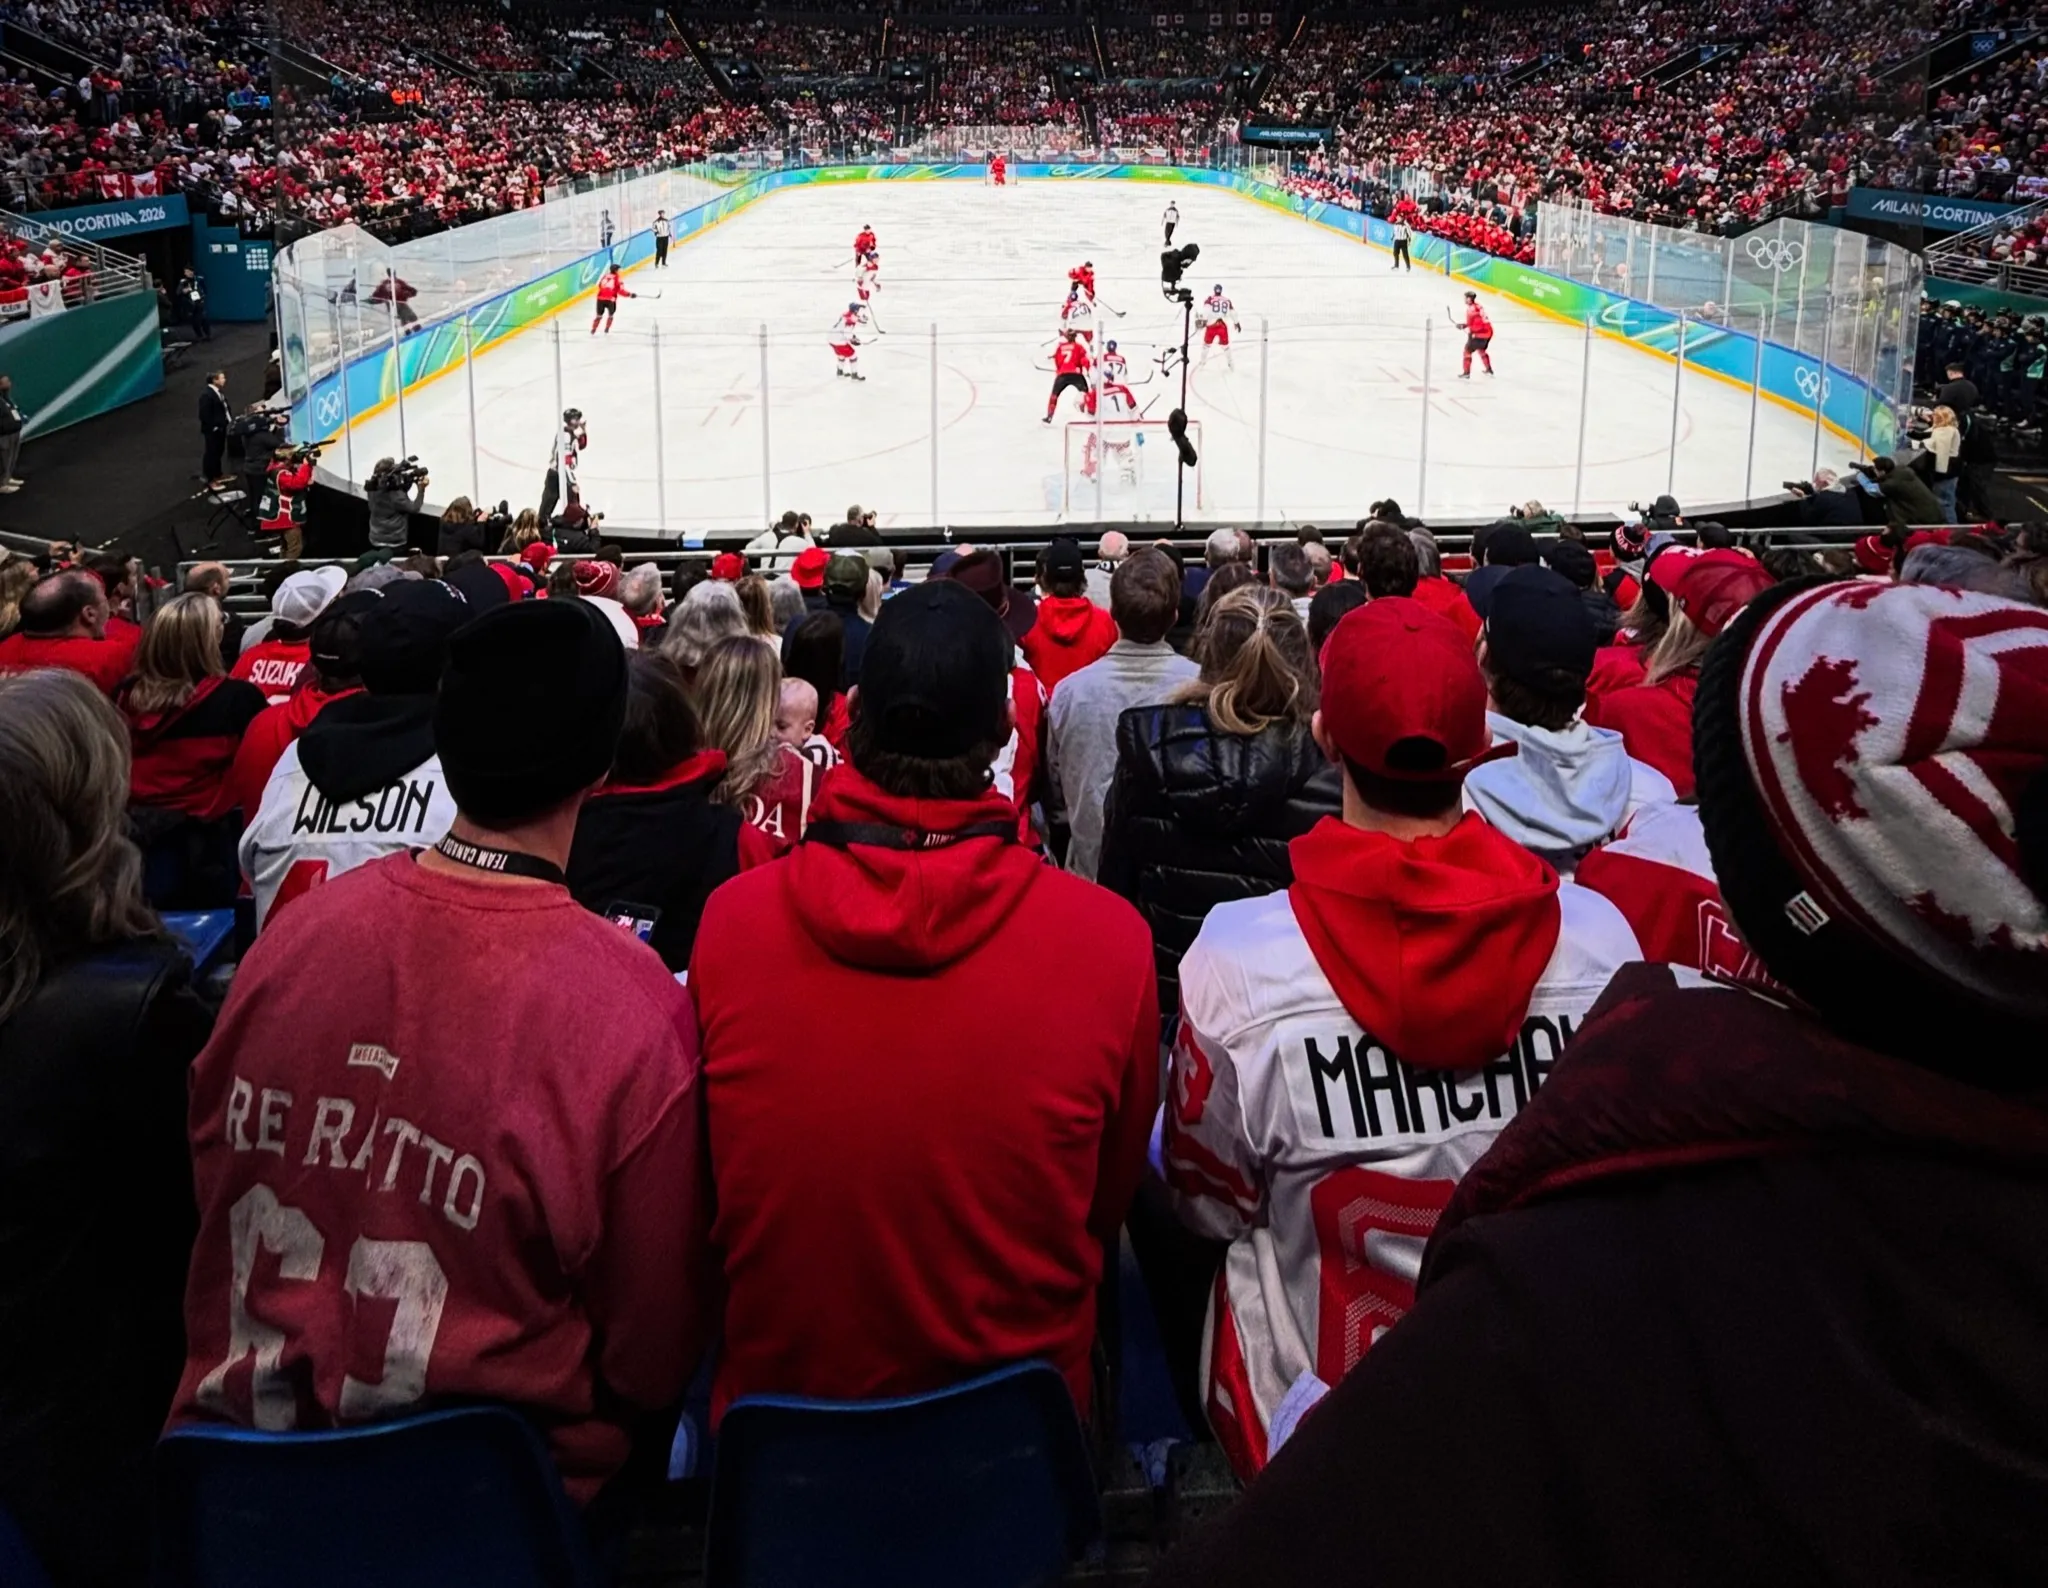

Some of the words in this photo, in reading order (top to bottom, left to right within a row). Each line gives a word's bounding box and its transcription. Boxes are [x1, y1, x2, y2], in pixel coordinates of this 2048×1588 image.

[75, 212, 138, 232] CORTINA
[138, 206, 166, 223] 2026
[1871, 199, 1931, 217] MILANO
[1212, 300, 1228, 314] 88
[1061, 350, 1072, 364] 7
[292, 780, 435, 835] WILSON
[475, 849, 508, 871] TEAM
[1304, 1014, 1578, 1139] MARCHA
